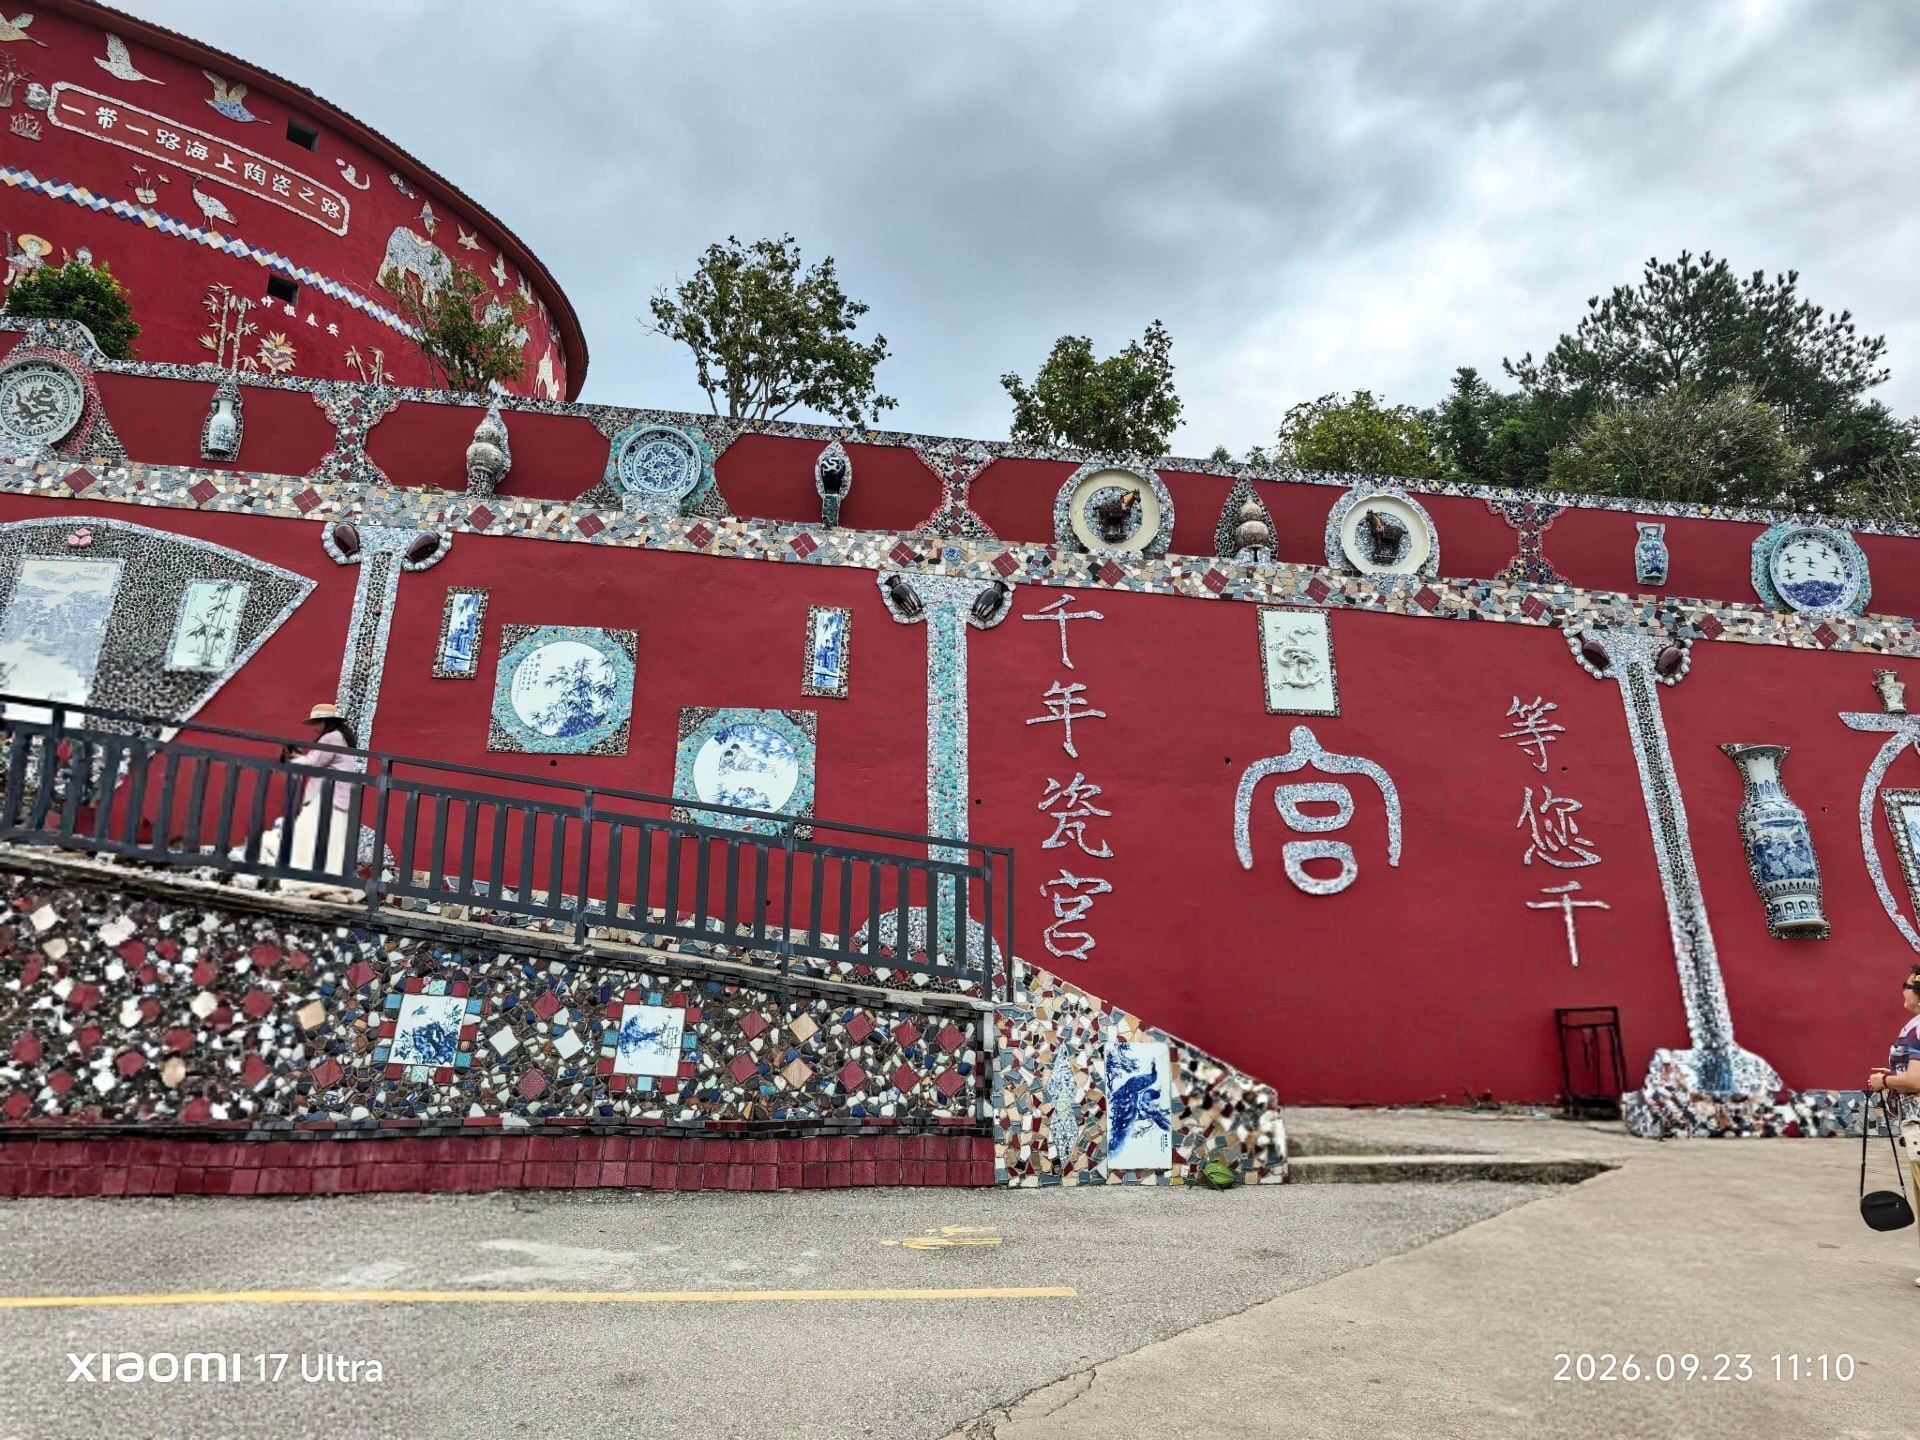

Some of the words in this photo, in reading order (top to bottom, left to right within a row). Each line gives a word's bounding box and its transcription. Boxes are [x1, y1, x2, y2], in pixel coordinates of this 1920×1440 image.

[61, 102, 341, 220] 一带一路海上陶瓷之路
[1022, 593, 1114, 961] 千年瓷宫
